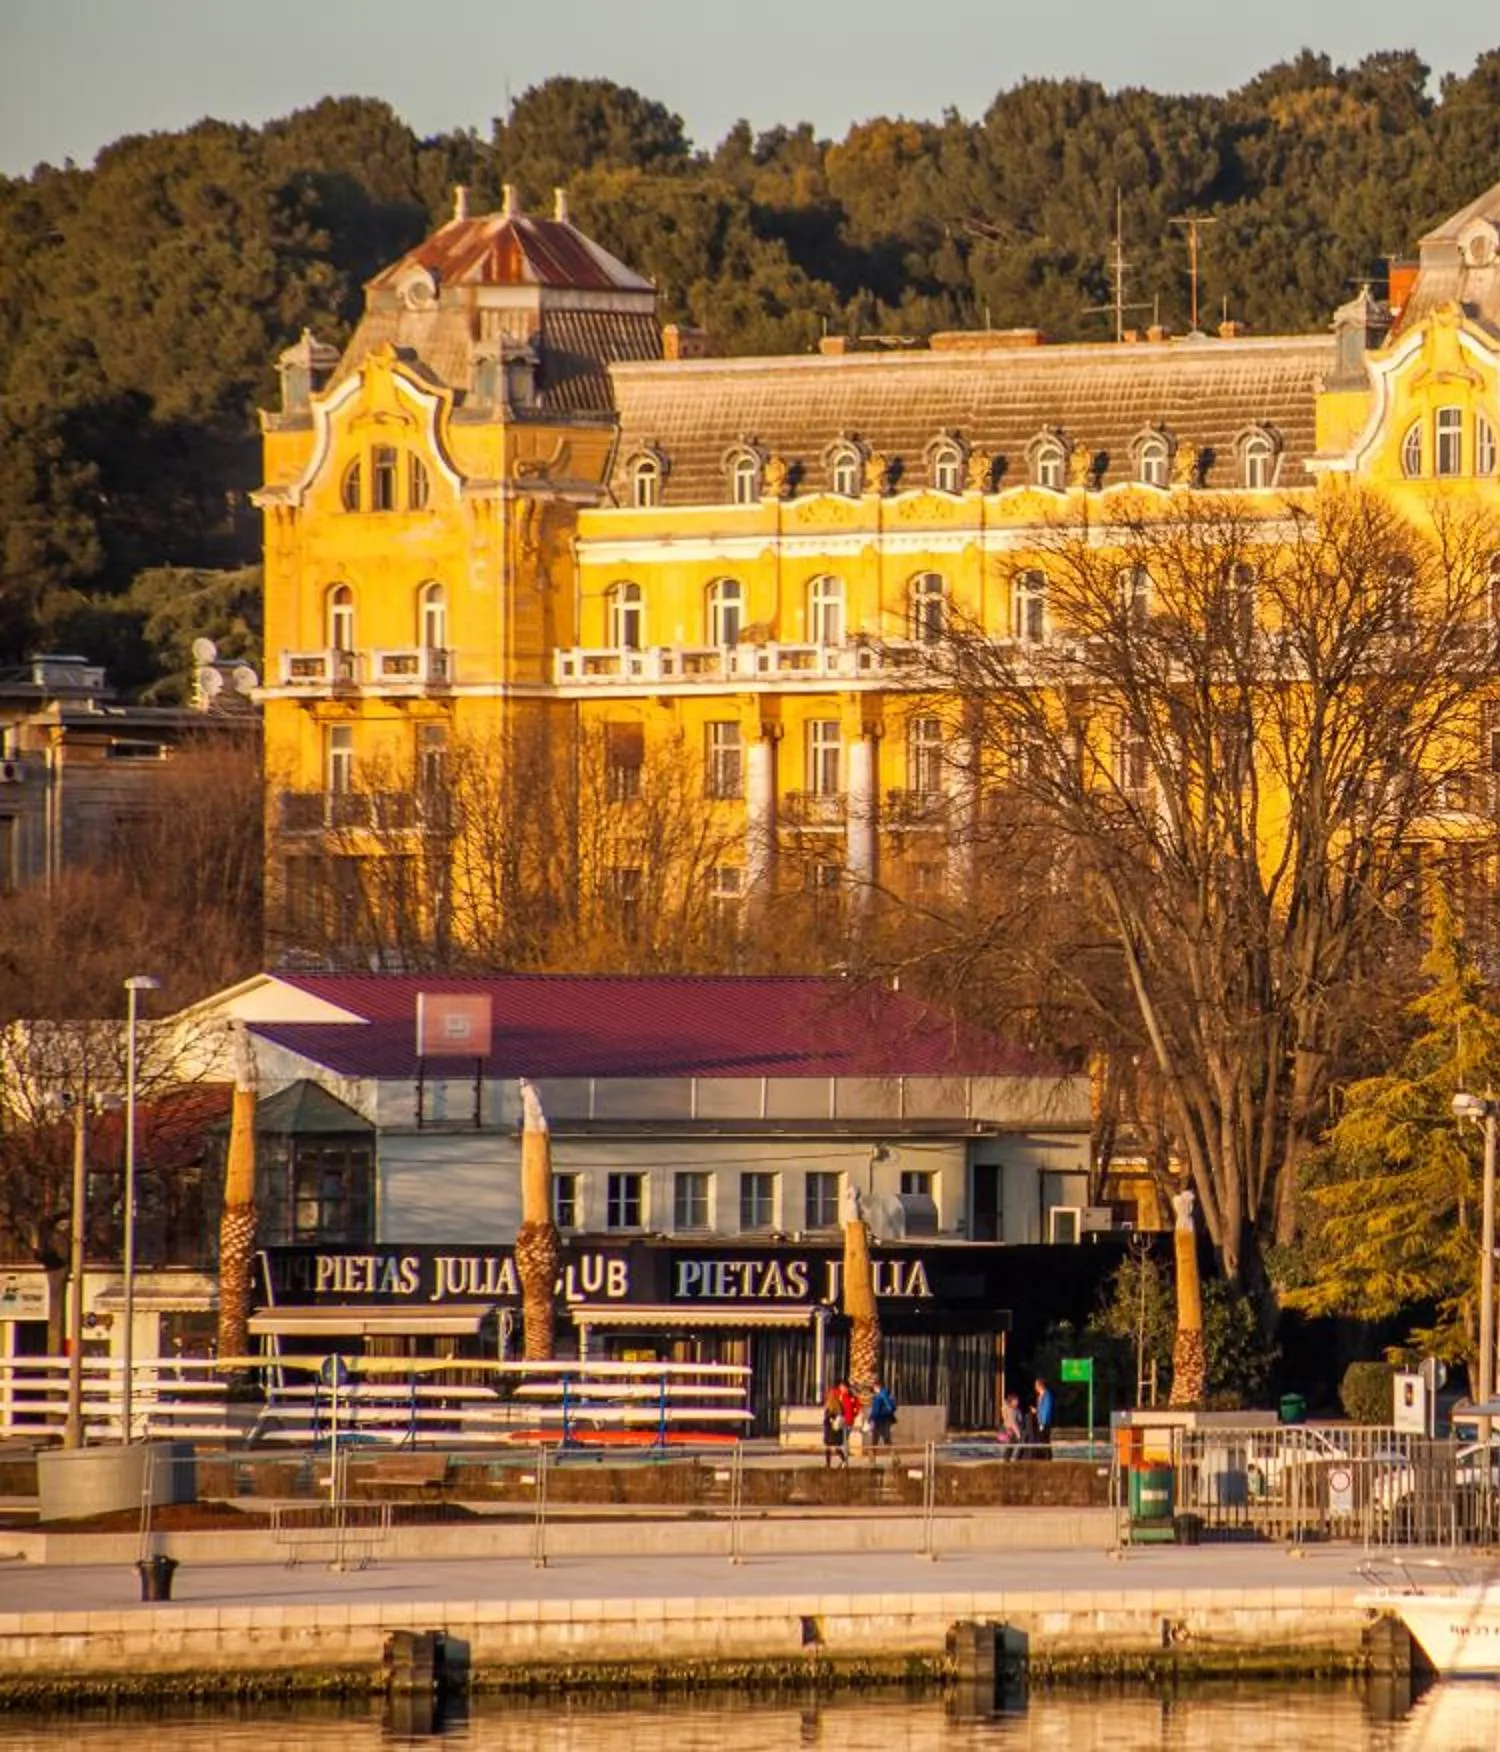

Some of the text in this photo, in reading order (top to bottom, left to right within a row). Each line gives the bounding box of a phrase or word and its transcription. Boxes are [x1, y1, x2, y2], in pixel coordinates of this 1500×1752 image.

[315, 1255, 420, 1294] PIETAS
[430, 1257, 520, 1301] JULIA
[554, 1254, 629, 1302] LUB
[675, 1260, 933, 1304] PIETAS JLIA
